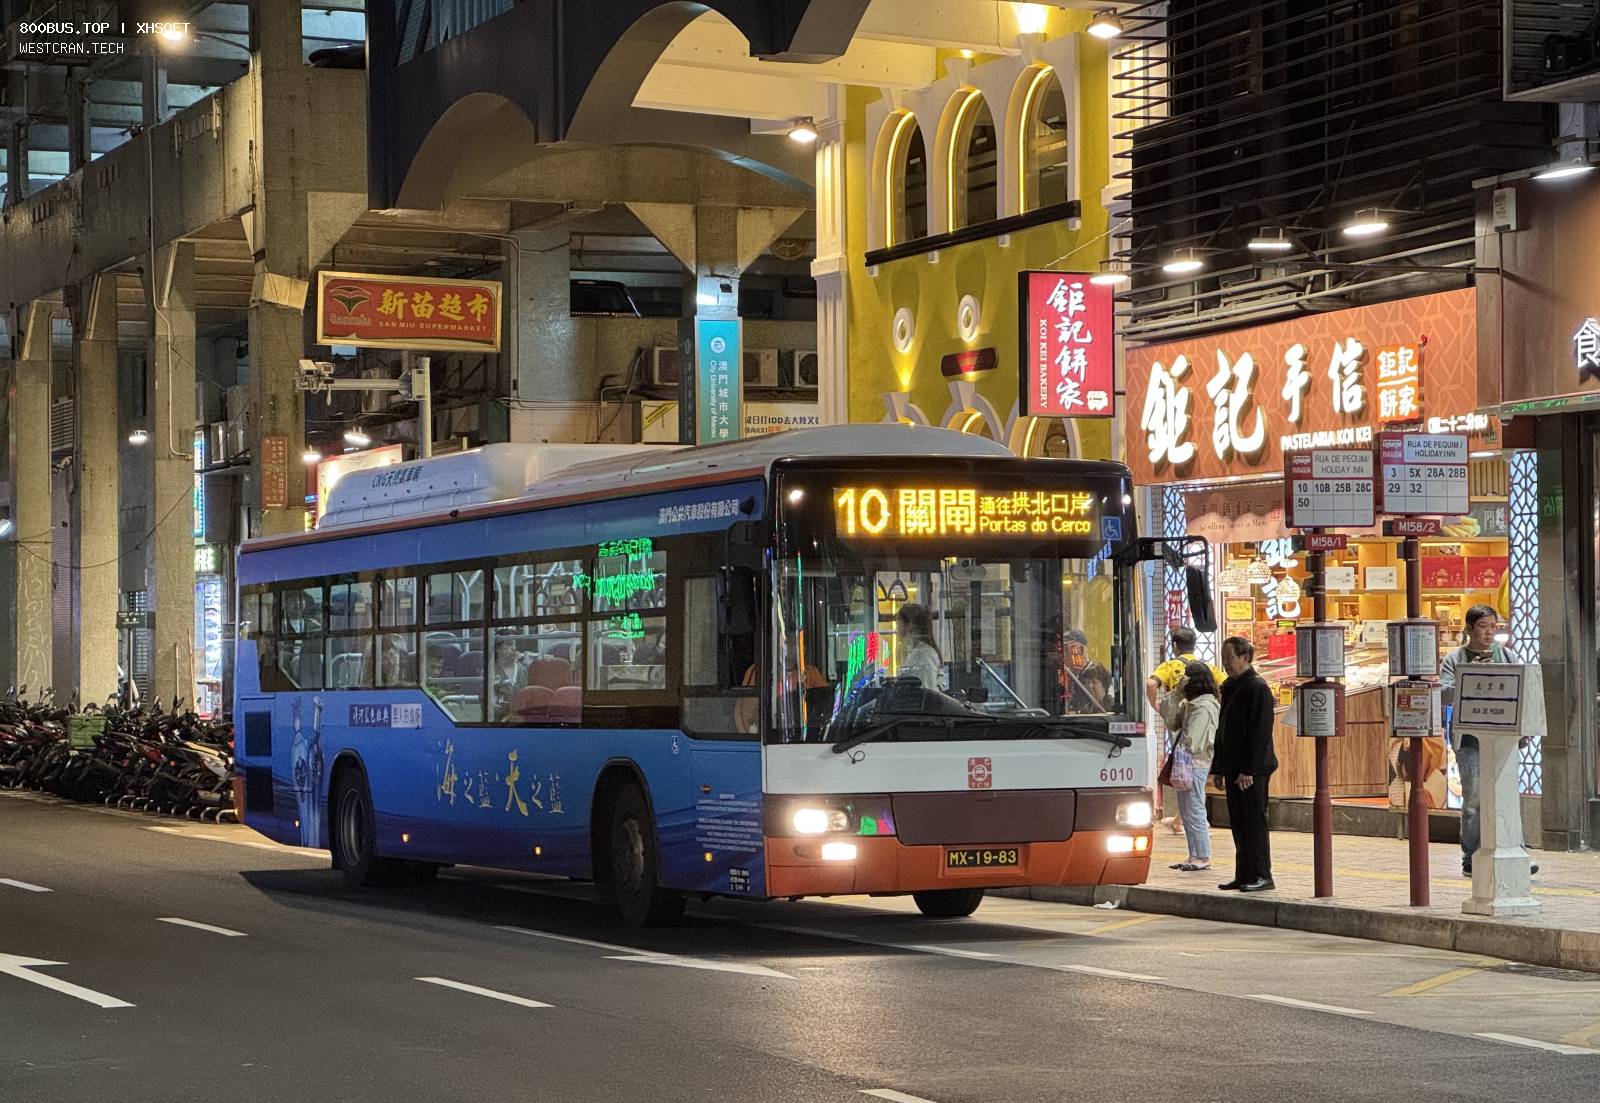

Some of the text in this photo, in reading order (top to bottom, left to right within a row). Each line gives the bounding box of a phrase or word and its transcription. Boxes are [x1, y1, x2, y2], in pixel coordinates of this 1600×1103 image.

[376, 288, 490, 323] 新苗超市
[420, 322, 488, 332] SUPERMARKET
[1046, 278, 1093, 410] 鉅記餅家
[1573, 318, 1600, 368] 食
[708, 360, 717, 373] City
[1039, 319, 1047, 409] KOI KEI BAKERY
[1377, 346, 1418, 379] 鉅記
[709, 373, 717, 408] University
[718, 360, 729, 439] 澳門城市大學
[1141, 337, 1366, 465] 鉅記手信
[709, 415, 717, 438] Macau
[1281, 430, 1338, 450] PASTELARIA
[1407, 440, 1421, 448] RUA
[1423, 441, 1433, 449] DE
[1315, 454, 1329, 463] RUA
[1331, 455, 1341, 463] DE
[1415, 449, 1456, 458] HOLIDAY INN
[1321, 465, 1364, 474] HOLIDAY INN
[1391, 467, 1466, 478] 3 5X 28A 28B
[1298, 483, 1371, 493] 10 10B 25B 28C
[1388, 483, 1422, 493] 29 32
[1298, 498, 1310, 508] 50
[836, 488, 890, 534] 10
[899, 488, 976, 534] 關閘
[979, 517, 1091, 533] Portas do Cerco
[1399, 522, 1436, 533] M158/2
[1311, 537, 1341, 547] M158/1
[1100, 767, 1133, 781] 6010
[949, 850, 1017, 865] MX-19-83
